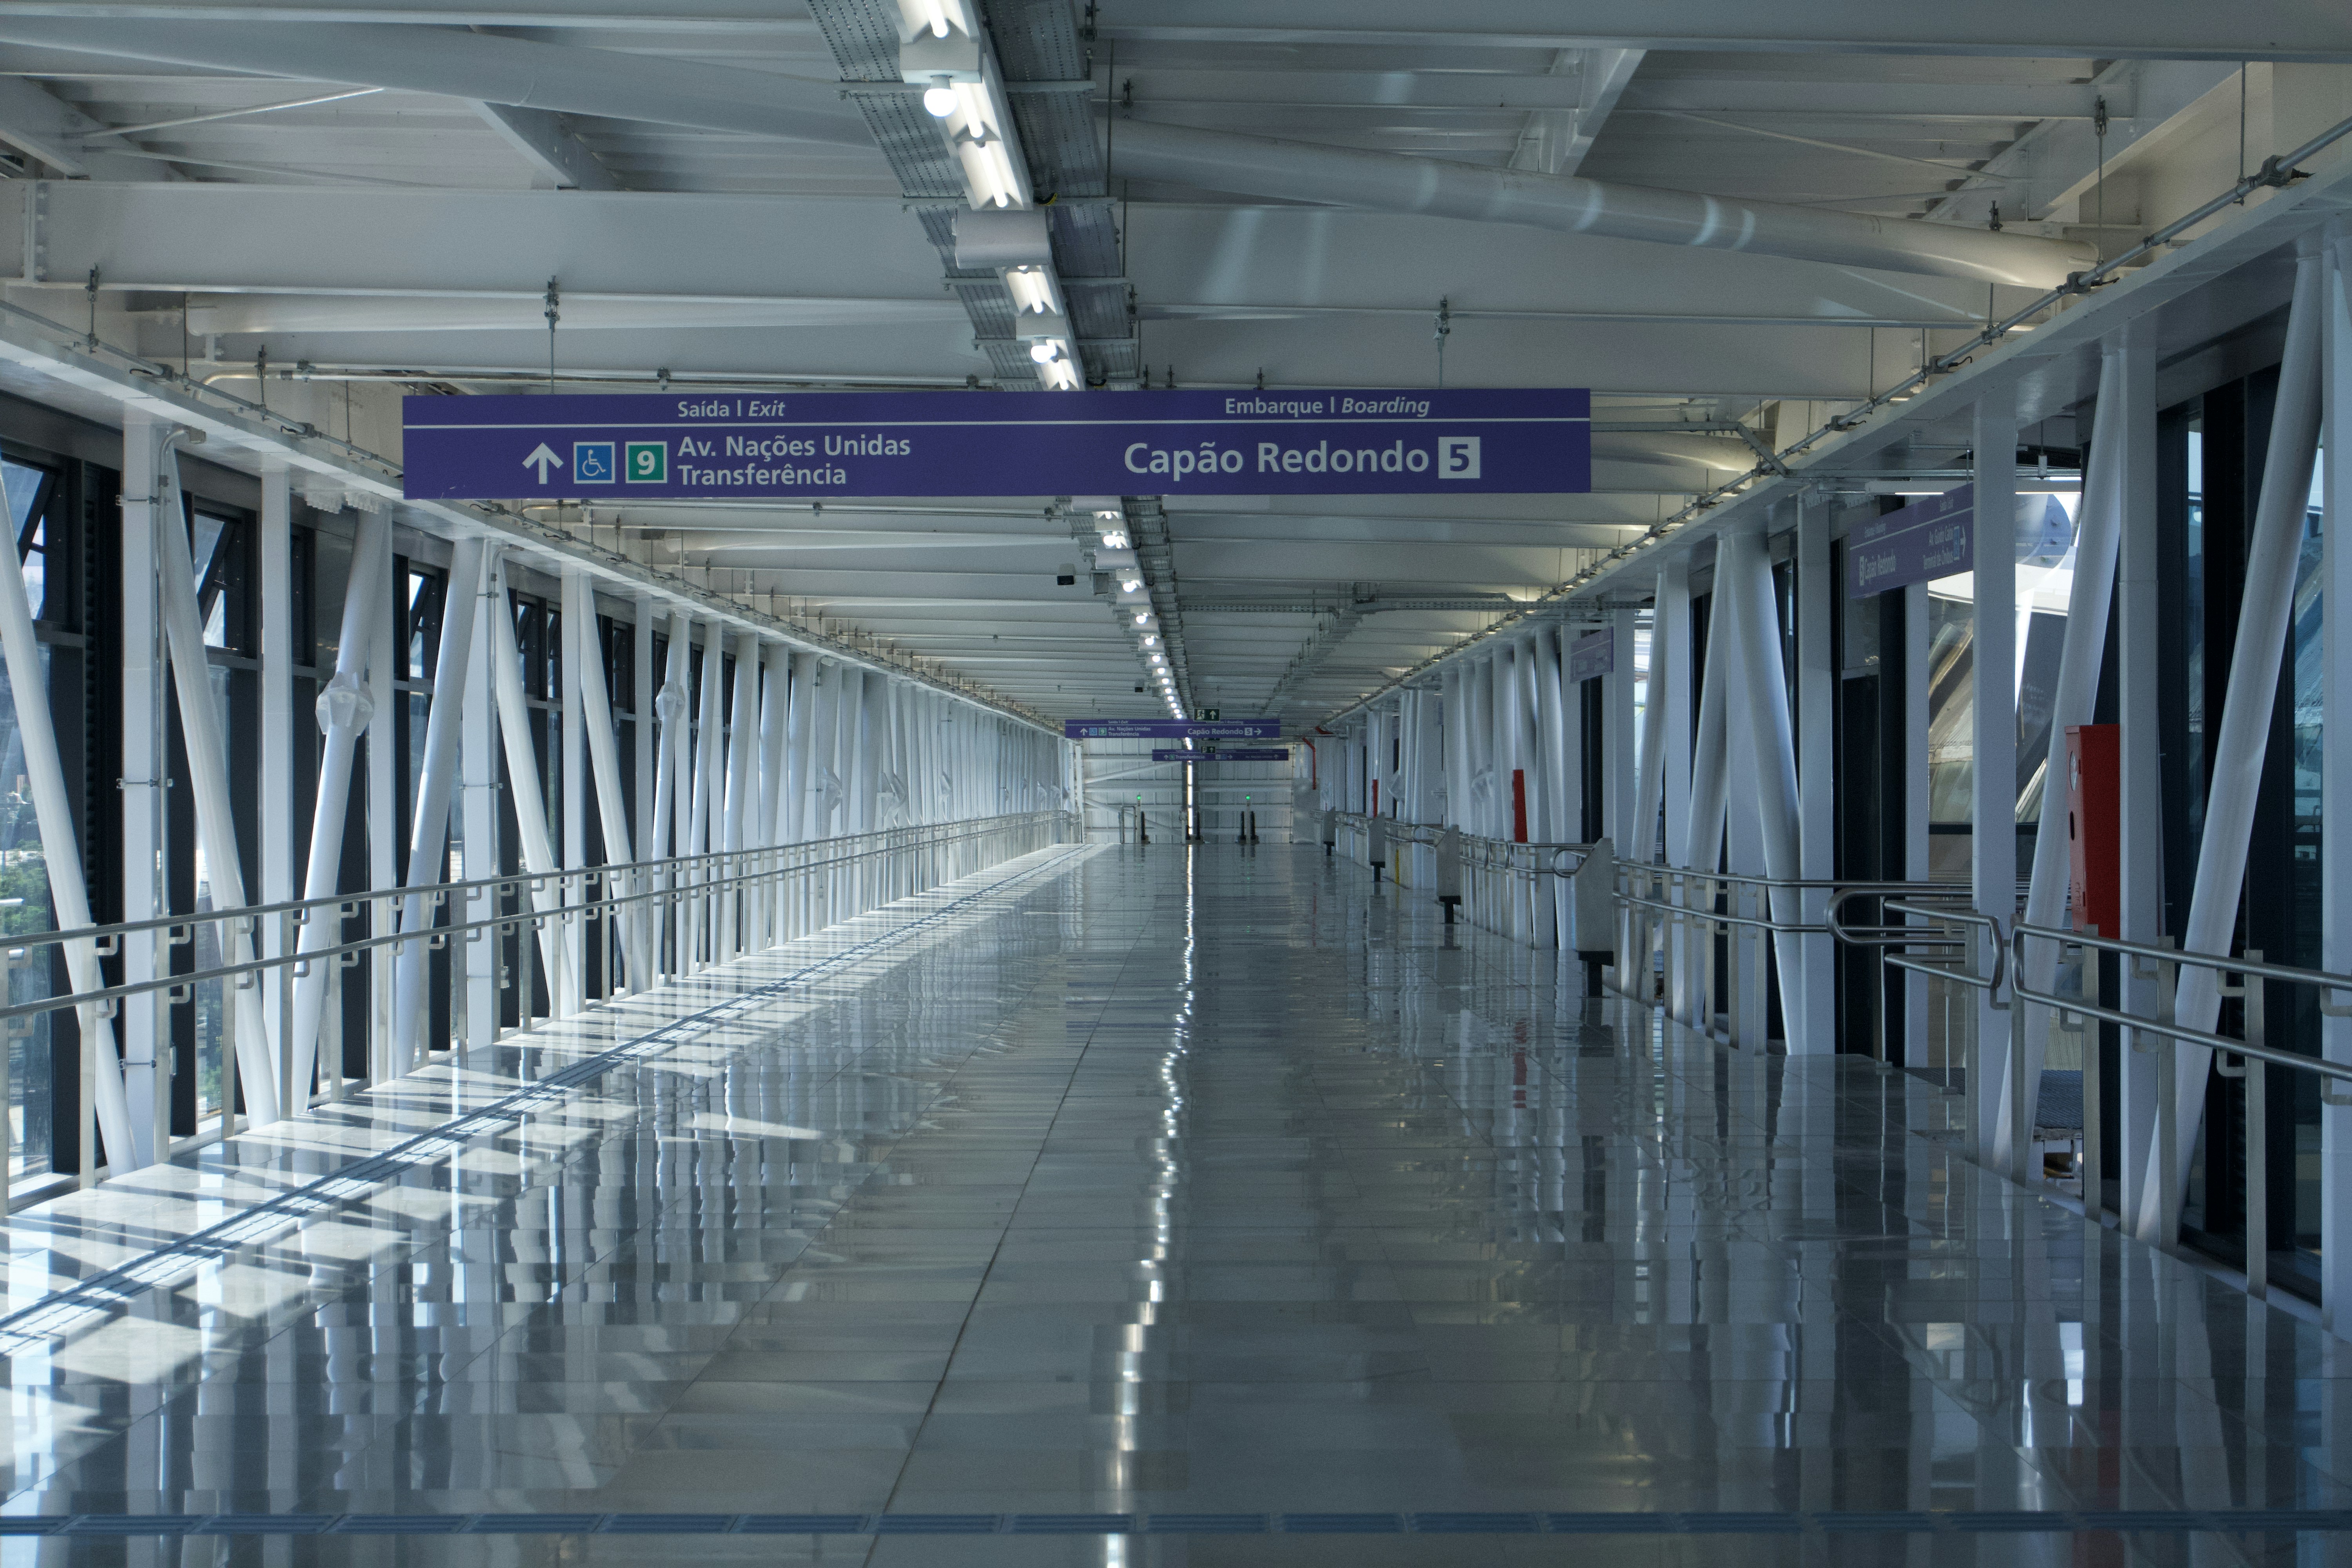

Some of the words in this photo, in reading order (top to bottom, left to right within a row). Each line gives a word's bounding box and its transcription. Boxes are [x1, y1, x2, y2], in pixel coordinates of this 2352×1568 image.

[678, 400, 730, 417] Saída
[748, 400, 785, 417] Exit
[1226, 397, 1323, 417] Embarque
[1341, 396, 1430, 417] Boarding
[677, 436, 716, 456] Av.
[726, 435, 815, 462] Nações
[825, 434, 910, 456] Unidas
[1124, 441, 1243, 482] Capão
[1258, 439, 1429, 473] Redondo
[1450, 444, 1469, 472] 5
[637, 450, 655, 475] 9
[677, 463, 846, 485] Transferência
[1877, 548, 1896, 575] Redondo
